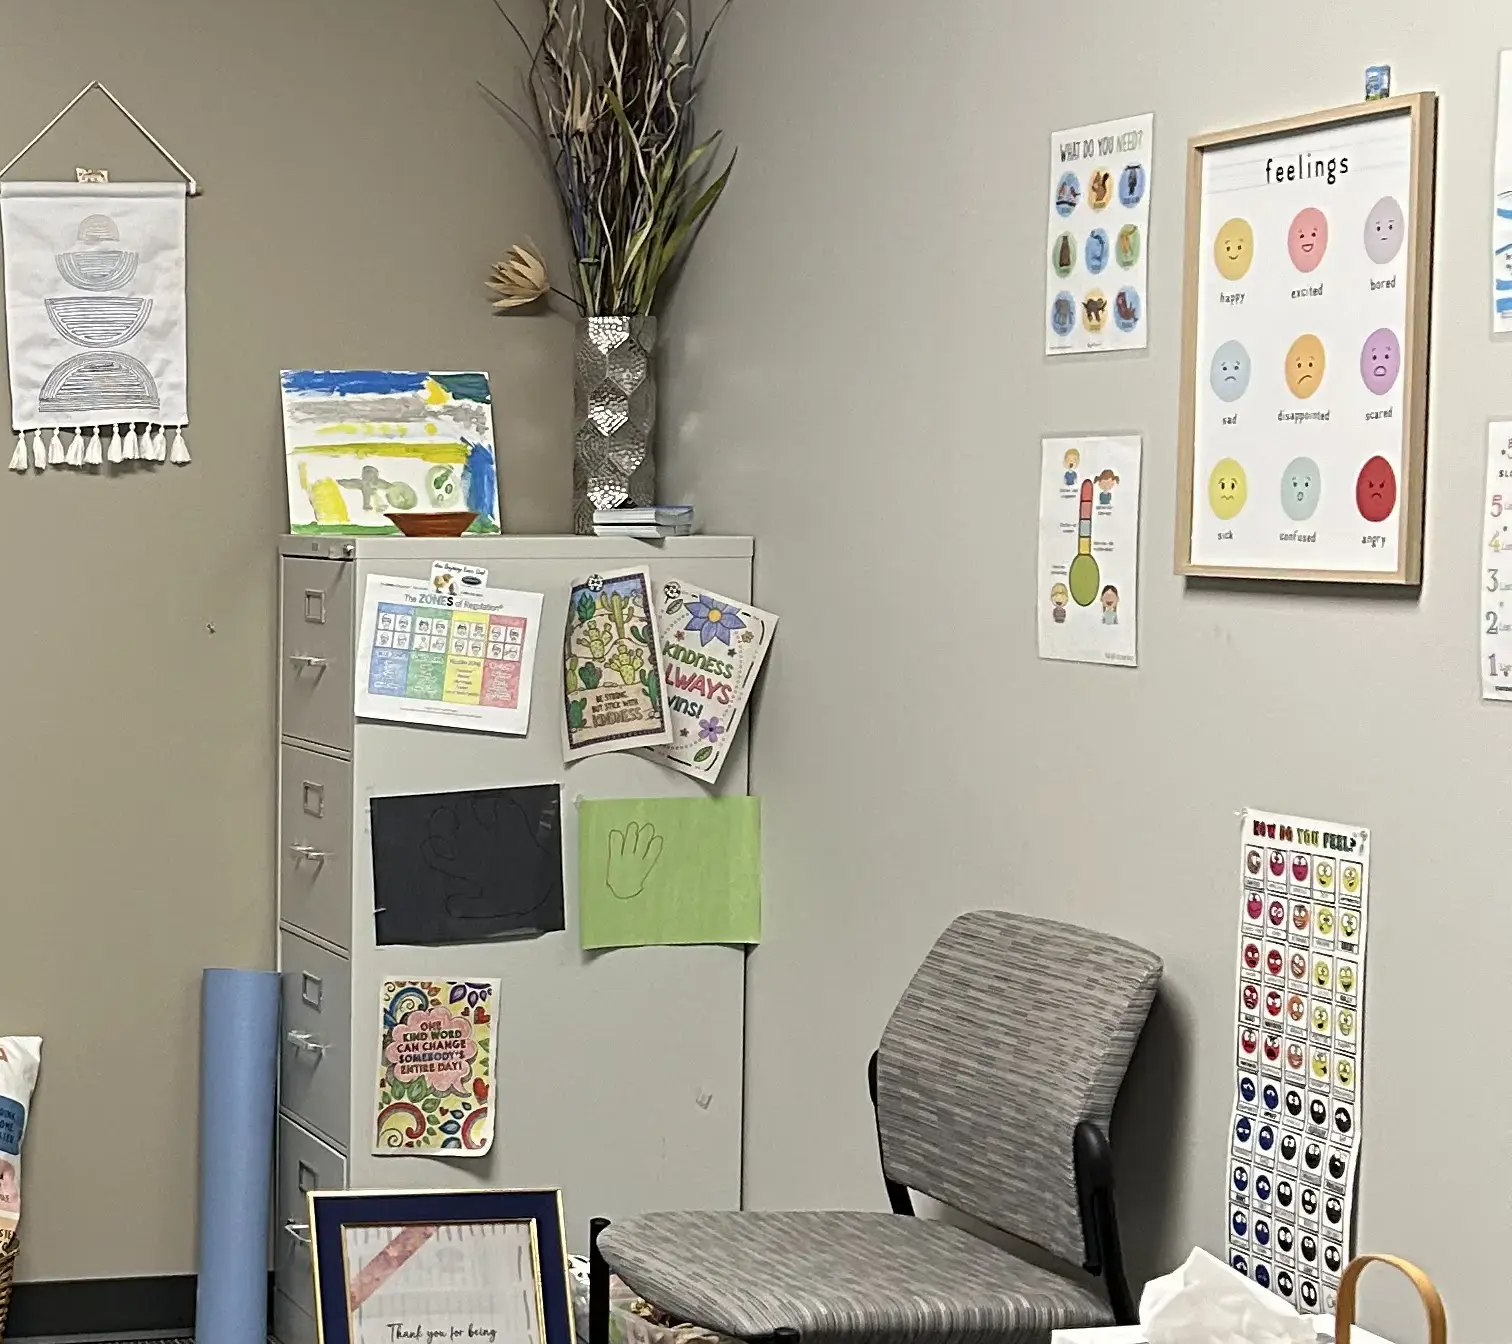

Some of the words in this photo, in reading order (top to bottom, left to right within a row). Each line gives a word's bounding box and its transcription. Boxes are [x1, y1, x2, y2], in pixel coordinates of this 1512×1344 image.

[1060, 141, 1081, 162] WHAT
[1083, 139, 1094, 158] DO
[1098, 136, 1114, 156] YOU
[1116, 130, 1143, 152] NEED?
[1265, 153, 1349, 185] feelings
[1370, 275, 1396, 290] bored
[1220, 292, 1245, 305] happy
[1291, 283, 1323, 299] excited
[1222, 413, 1237, 425] sad
[1277, 409, 1330, 424] disappointed
[1365, 407, 1393, 421] scared
[1490, 494, 1503, 517] 5
[1217, 530, 1233, 540] sick
[1279, 529, 1316, 543] confused
[1361, 534, 1386, 548] angry
[1487, 568, 1499, 593] 3
[418, 593, 454, 607] ZONES
[1485, 611, 1498, 635] 2
[664, 663, 733, 705] LWAYS
[592, 708, 644, 728] KINDNESS
[1253, 819, 1276, 840] HOW
[1279, 824, 1294, 842] DO
[1296, 827, 1320, 845] YOU
[1323, 832, 1357, 853] FEEL?
[420, 1020, 442, 1031] ONE
[403, 1032, 428, 1042] KIND
[431, 1029, 462, 1040] WORD
[396, 1042, 419, 1053] CAN
[422, 1039, 466, 1051] CHANGE
[400, 1063, 436, 1075] ENTIRE
[387, 1322, 423, 1342] Thank
[427, 1330, 447, 1344] you
[450, 1326, 464, 1342] for
[468, 1323, 498, 1343] being
